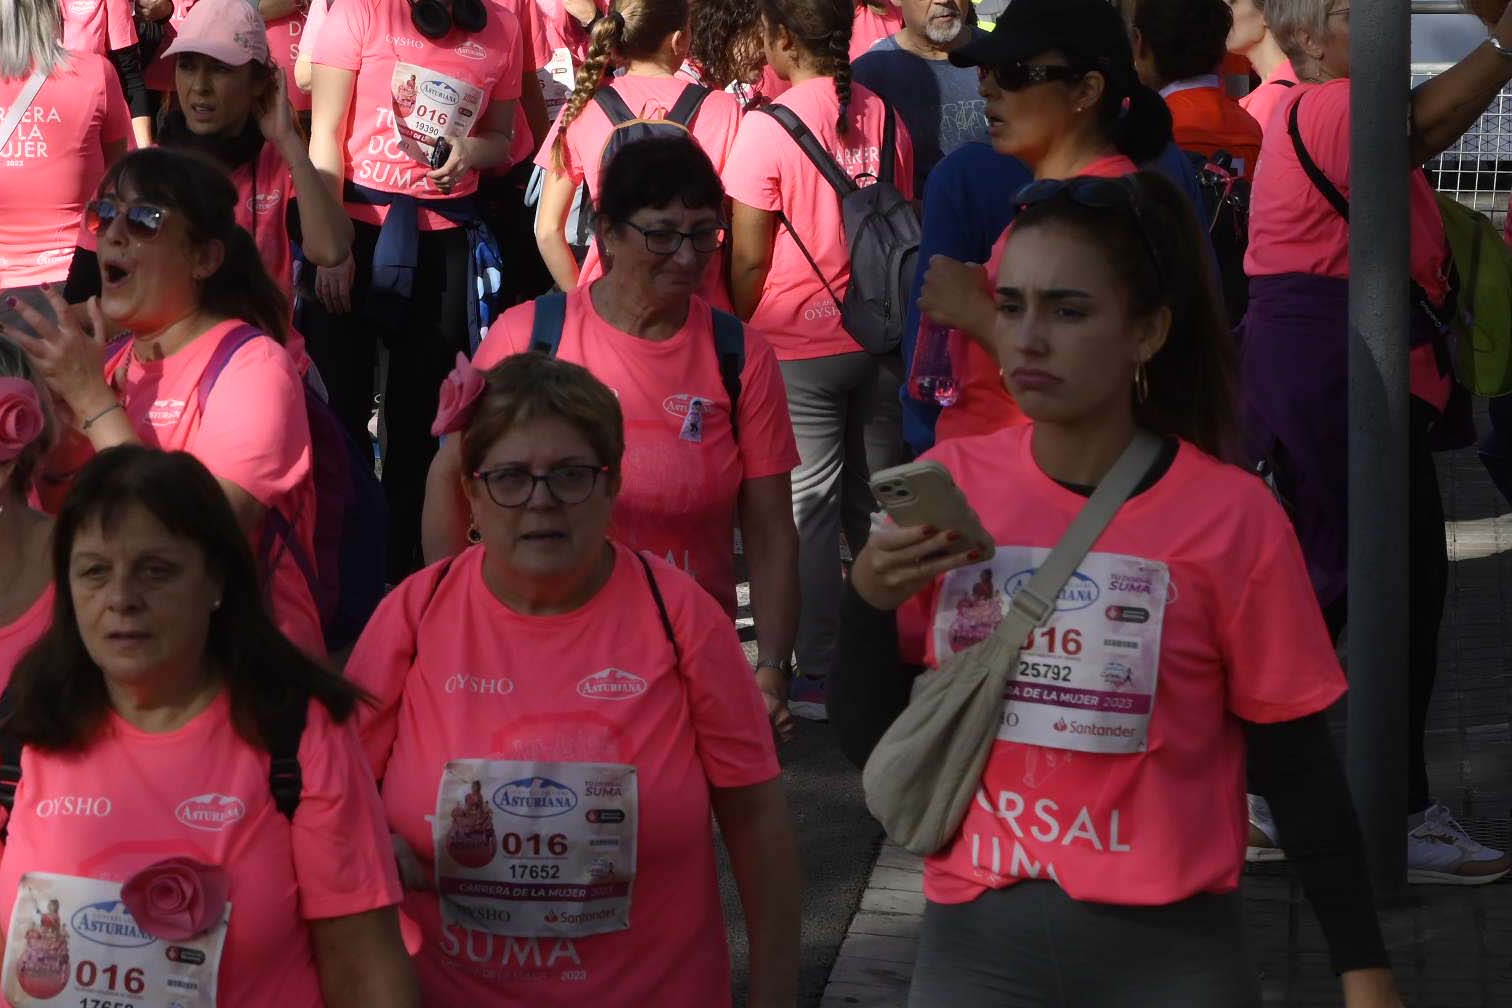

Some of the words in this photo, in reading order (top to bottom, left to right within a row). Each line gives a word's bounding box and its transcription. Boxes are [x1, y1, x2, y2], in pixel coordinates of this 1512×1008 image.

[424, 84, 456, 103] ASTURIANA
[417, 105, 448, 125] 016
[416, 121, 439, 136] 19390
[804, 305, 843, 321] OYSH
[1109, 581, 1152, 595] SUMA
[1019, 660, 1072, 683] 25792
[444, 673, 514, 696] OYSHO
[582, 680, 642, 694] ASTURIANA
[1024, 687, 1040, 699] DE
[1042, 690, 1058, 701] LA
[1060, 691, 1099, 707] MUJER
[1103, 696, 1134, 710] 2023
[1069, 720, 1136, 739] Santander
[500, 791, 571, 809] ASTURIANA
[585, 786, 623, 797] SUMA
[36, 796, 112, 818] OYSHO
[502, 832, 568, 857] 016
[509, 864, 561, 880] 17652
[459, 882, 510, 897] CARRERA
[513, 887, 529, 898] DE
[531, 888, 546, 898] LA
[548, 888, 587, 899] MUJER
[559, 907, 616, 925] Santander
[76, 960, 145, 995] 016
[560, 969, 587, 982] 2023
